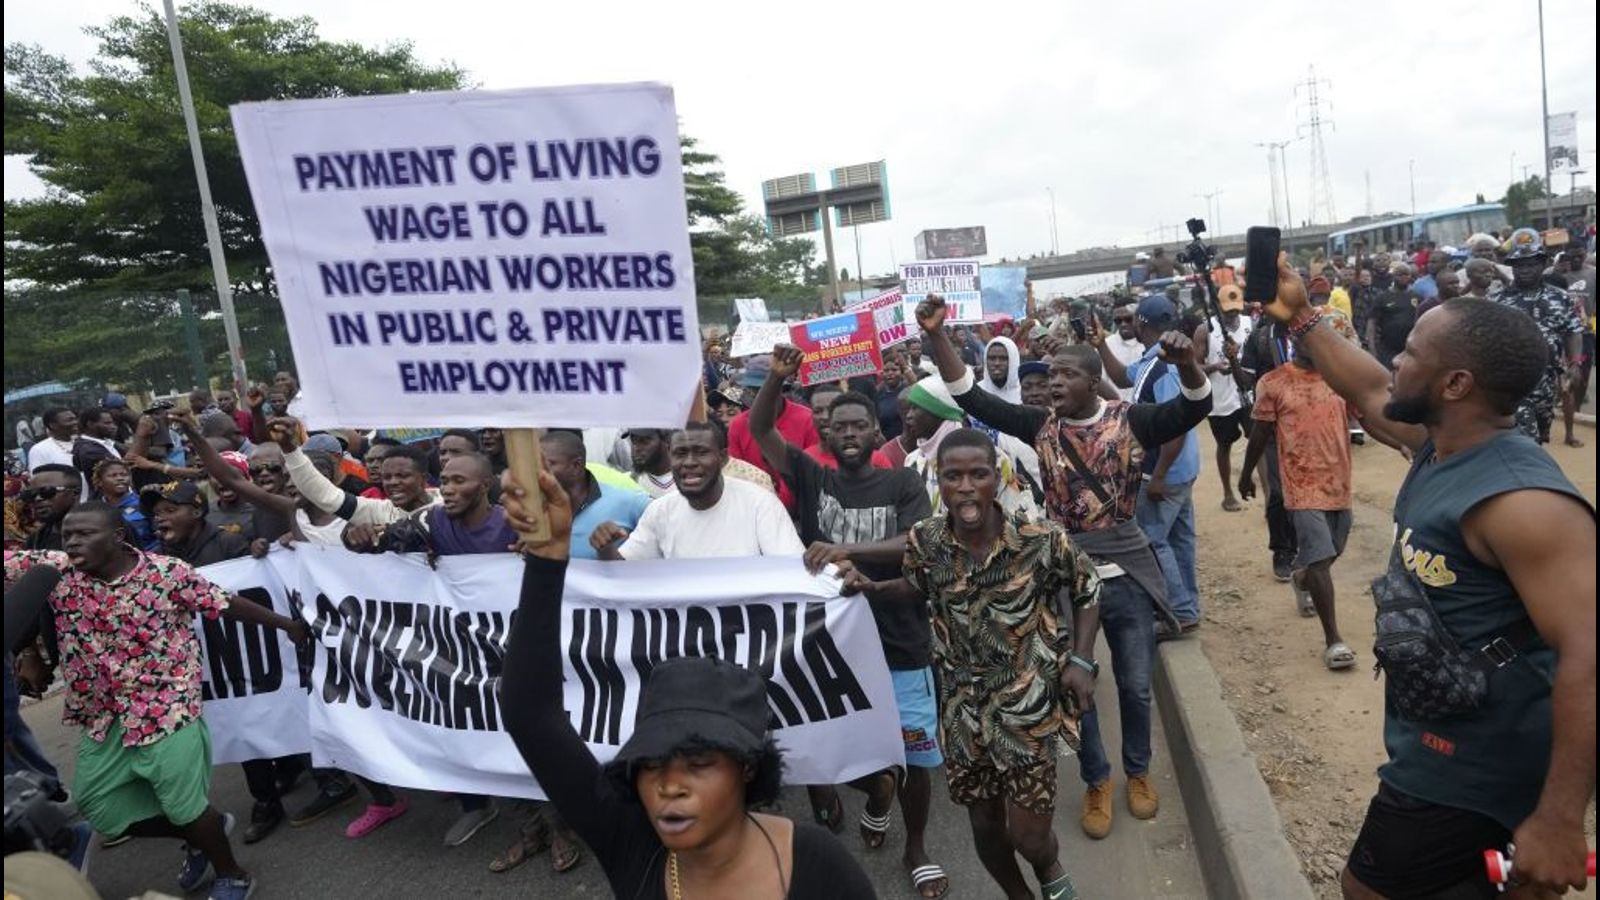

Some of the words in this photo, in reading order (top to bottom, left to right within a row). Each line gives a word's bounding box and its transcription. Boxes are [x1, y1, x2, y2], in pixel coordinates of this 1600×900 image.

[294, 147, 457, 192] PAYMENT
[467, 142, 518, 184] OF
[527, 136, 662, 181] LIVING
[364, 204, 472, 242] WAGE
[480, 200, 530, 239] TO
[540, 198, 606, 236] ALL
[318, 256, 492, 297] NIGERIAN
[497, 252, 676, 292] WORKERS
[904, 266, 925, 279] FOR
[927, 264, 974, 278] ANOTHER
[906, 277, 943, 294] GENERAL
[944, 276, 976, 292] STRIKE
[868, 293, 903, 310] SOCIALIS
[328, 312, 370, 347] IN
[378, 309, 498, 346] PUBLIC
[507, 309, 536, 343] &
[540, 306, 687, 344] PRIVATE
[819, 334, 851, 350] NEW
[880, 323, 907, 344] OW
[398, 360, 627, 395] EMPLOYMENT
[201, 587, 283, 701] ND
[312, 594, 570, 733] GOVERNAN
[569, 608, 627, 746] IN
